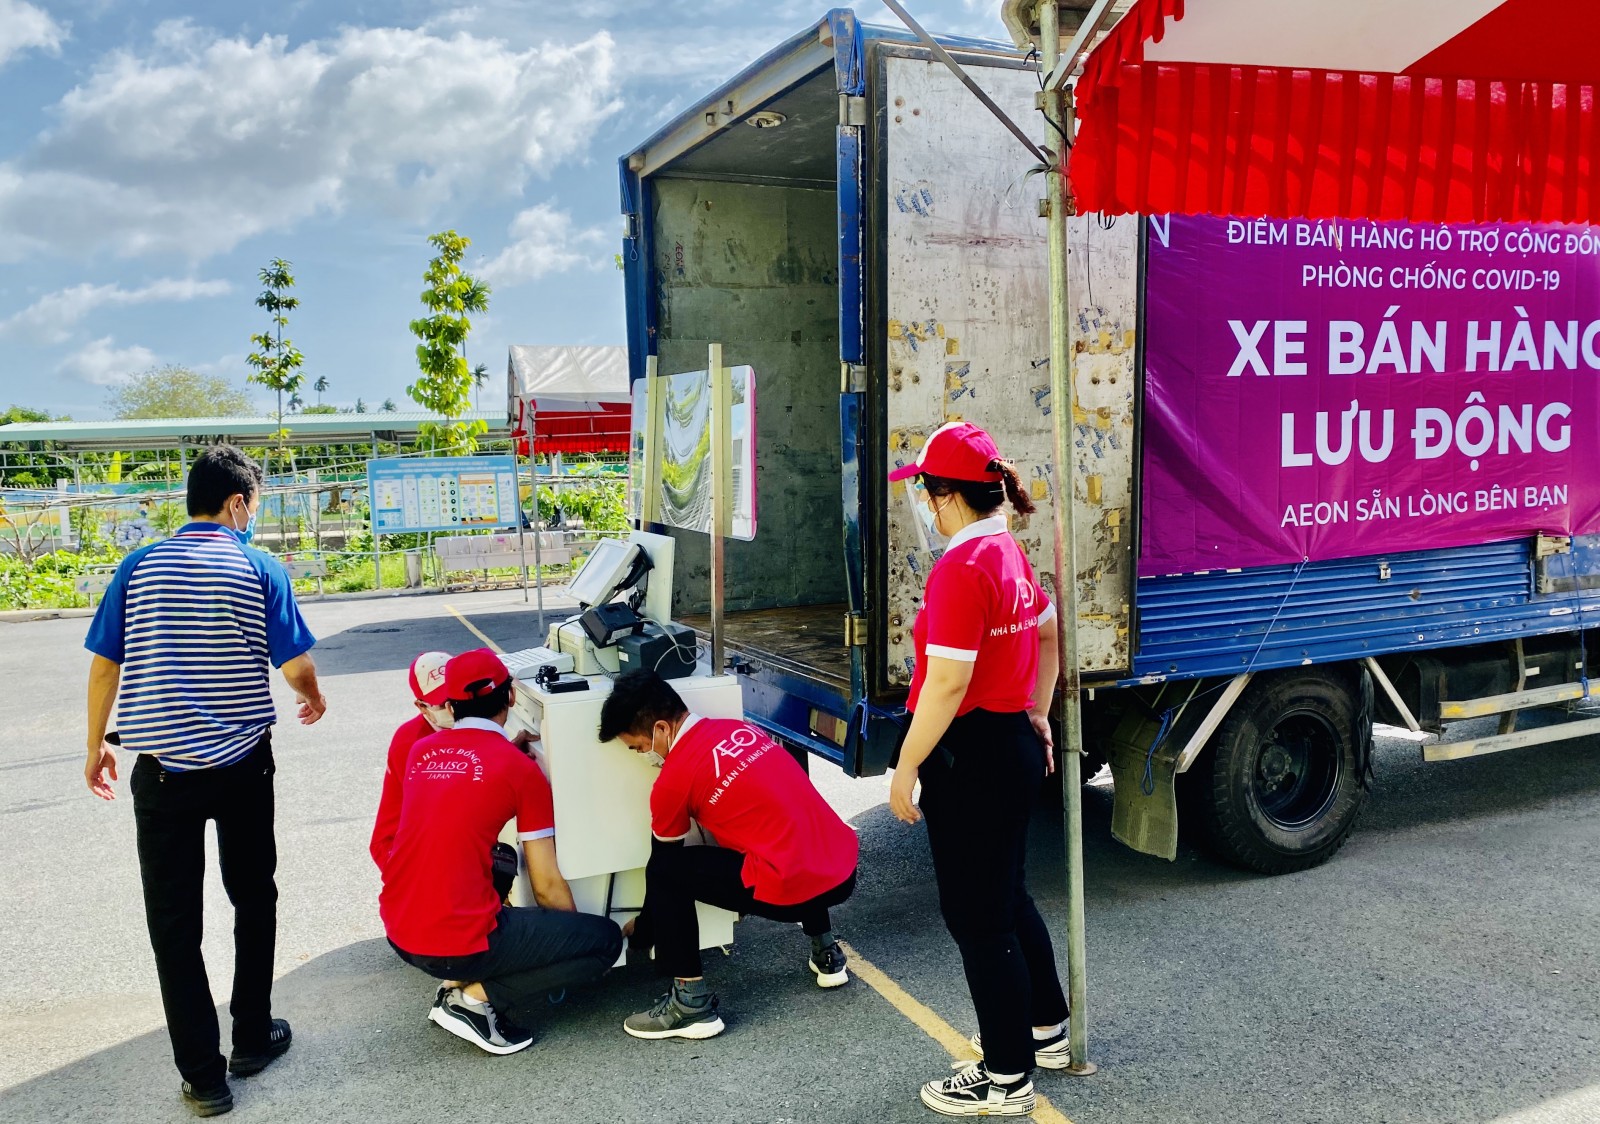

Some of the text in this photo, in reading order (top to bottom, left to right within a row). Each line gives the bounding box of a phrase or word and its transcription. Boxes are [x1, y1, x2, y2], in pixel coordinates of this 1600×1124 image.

[1296, 219, 1344, 247] BÁN
[1351, 221, 1414, 250] HÀNG
[1457, 227, 1500, 258] TRỢ
[1504, 227, 1561, 258] CỘNG
[1302, 260, 1560, 291] PHÒNG CHỐNG COVID-19
[1226, 319, 1308, 377] XE
[1328, 305, 1447, 375] BÁN
[1281, 391, 1572, 472] LƯU ĐỘNG
[1281, 483, 1568, 528] AEON SẴN LÒNG BÊN BẠN
[426, 761, 469, 771] DAISO
[721, 769, 739, 788] BÁN
